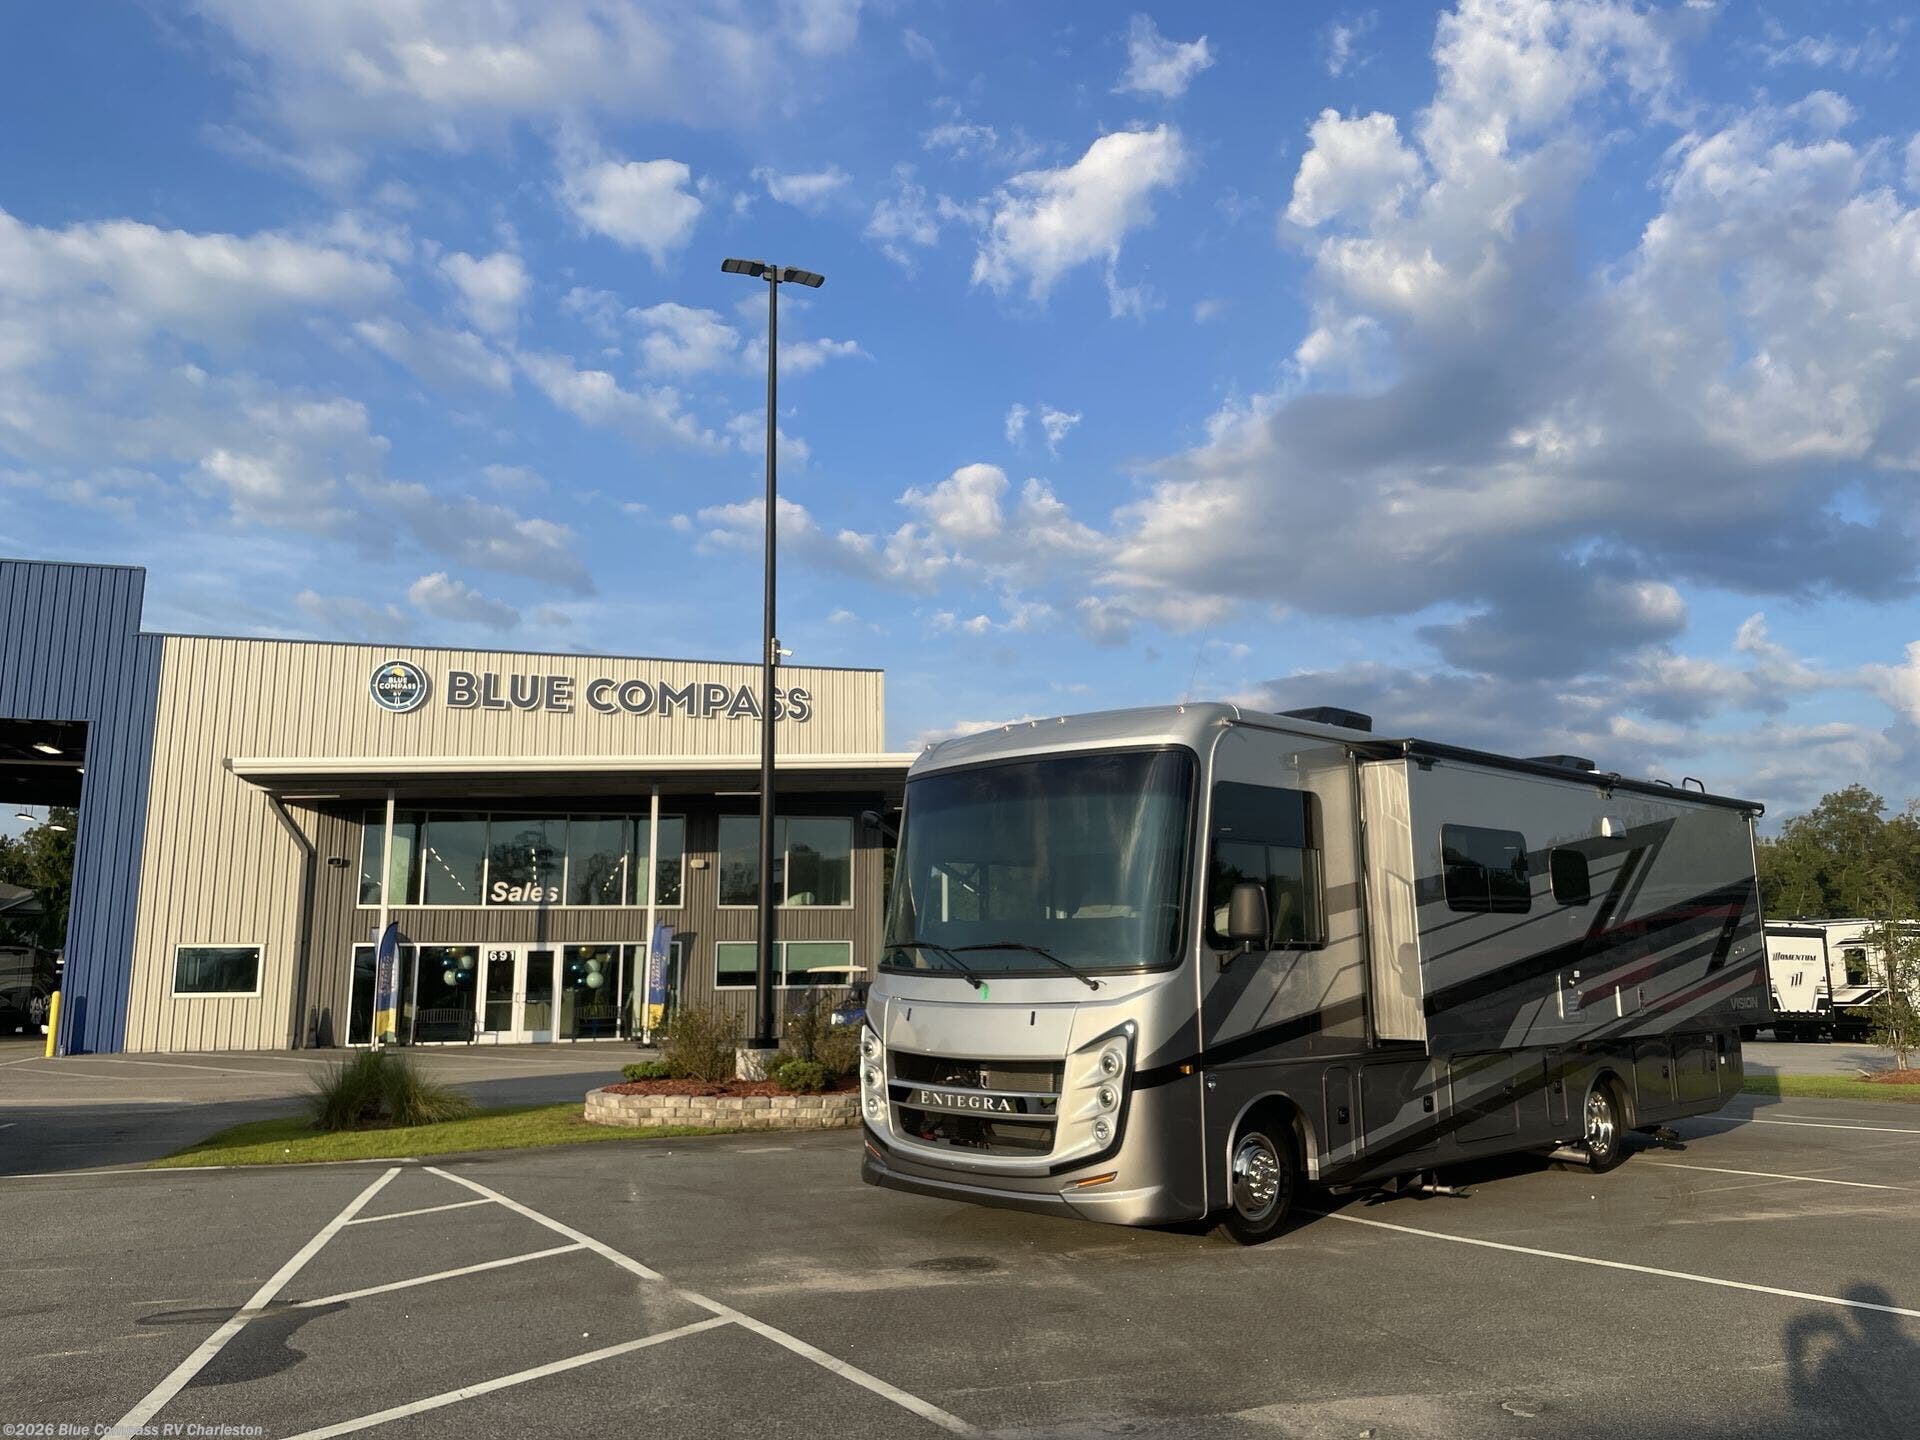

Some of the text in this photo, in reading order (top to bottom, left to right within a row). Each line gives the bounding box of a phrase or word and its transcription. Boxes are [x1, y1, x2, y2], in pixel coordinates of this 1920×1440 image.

[447, 670, 571, 712] BLUE
[490, 881, 559, 903] Sales
[489, 951, 515, 961] 691
[1772, 951, 1817, 961] MOMENTUM
[1730, 997, 1758, 1010] VISION
[920, 1090, 1011, 1111] ENTEGRA
